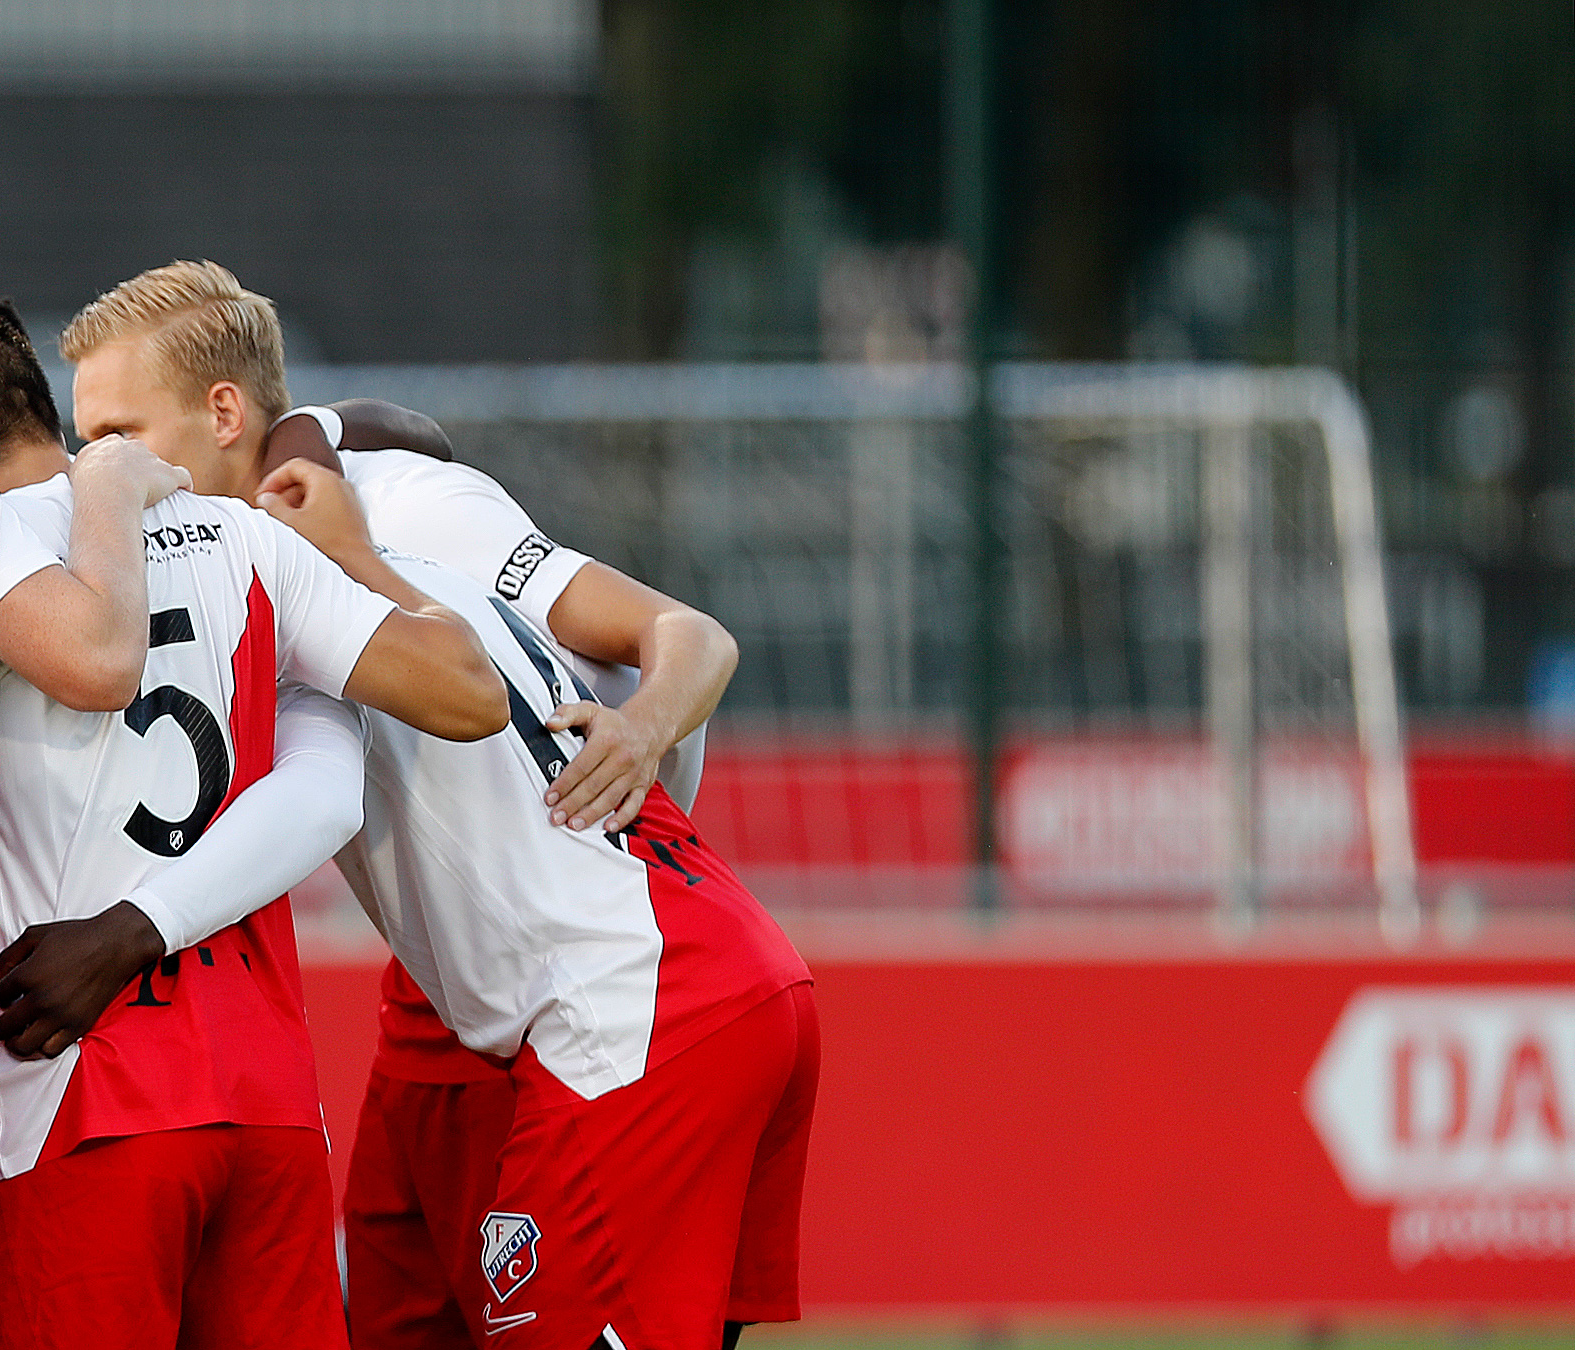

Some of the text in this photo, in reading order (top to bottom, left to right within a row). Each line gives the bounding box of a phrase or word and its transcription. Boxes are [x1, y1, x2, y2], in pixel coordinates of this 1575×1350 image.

[182, 521, 222, 545] EAT
[498, 533, 554, 597] DASSY
[122, 607, 230, 858] 5
[488, 1223, 532, 1279] UTRECHT
[496, 1223, 504, 1243] F
[508, 1259, 522, 1279] C
